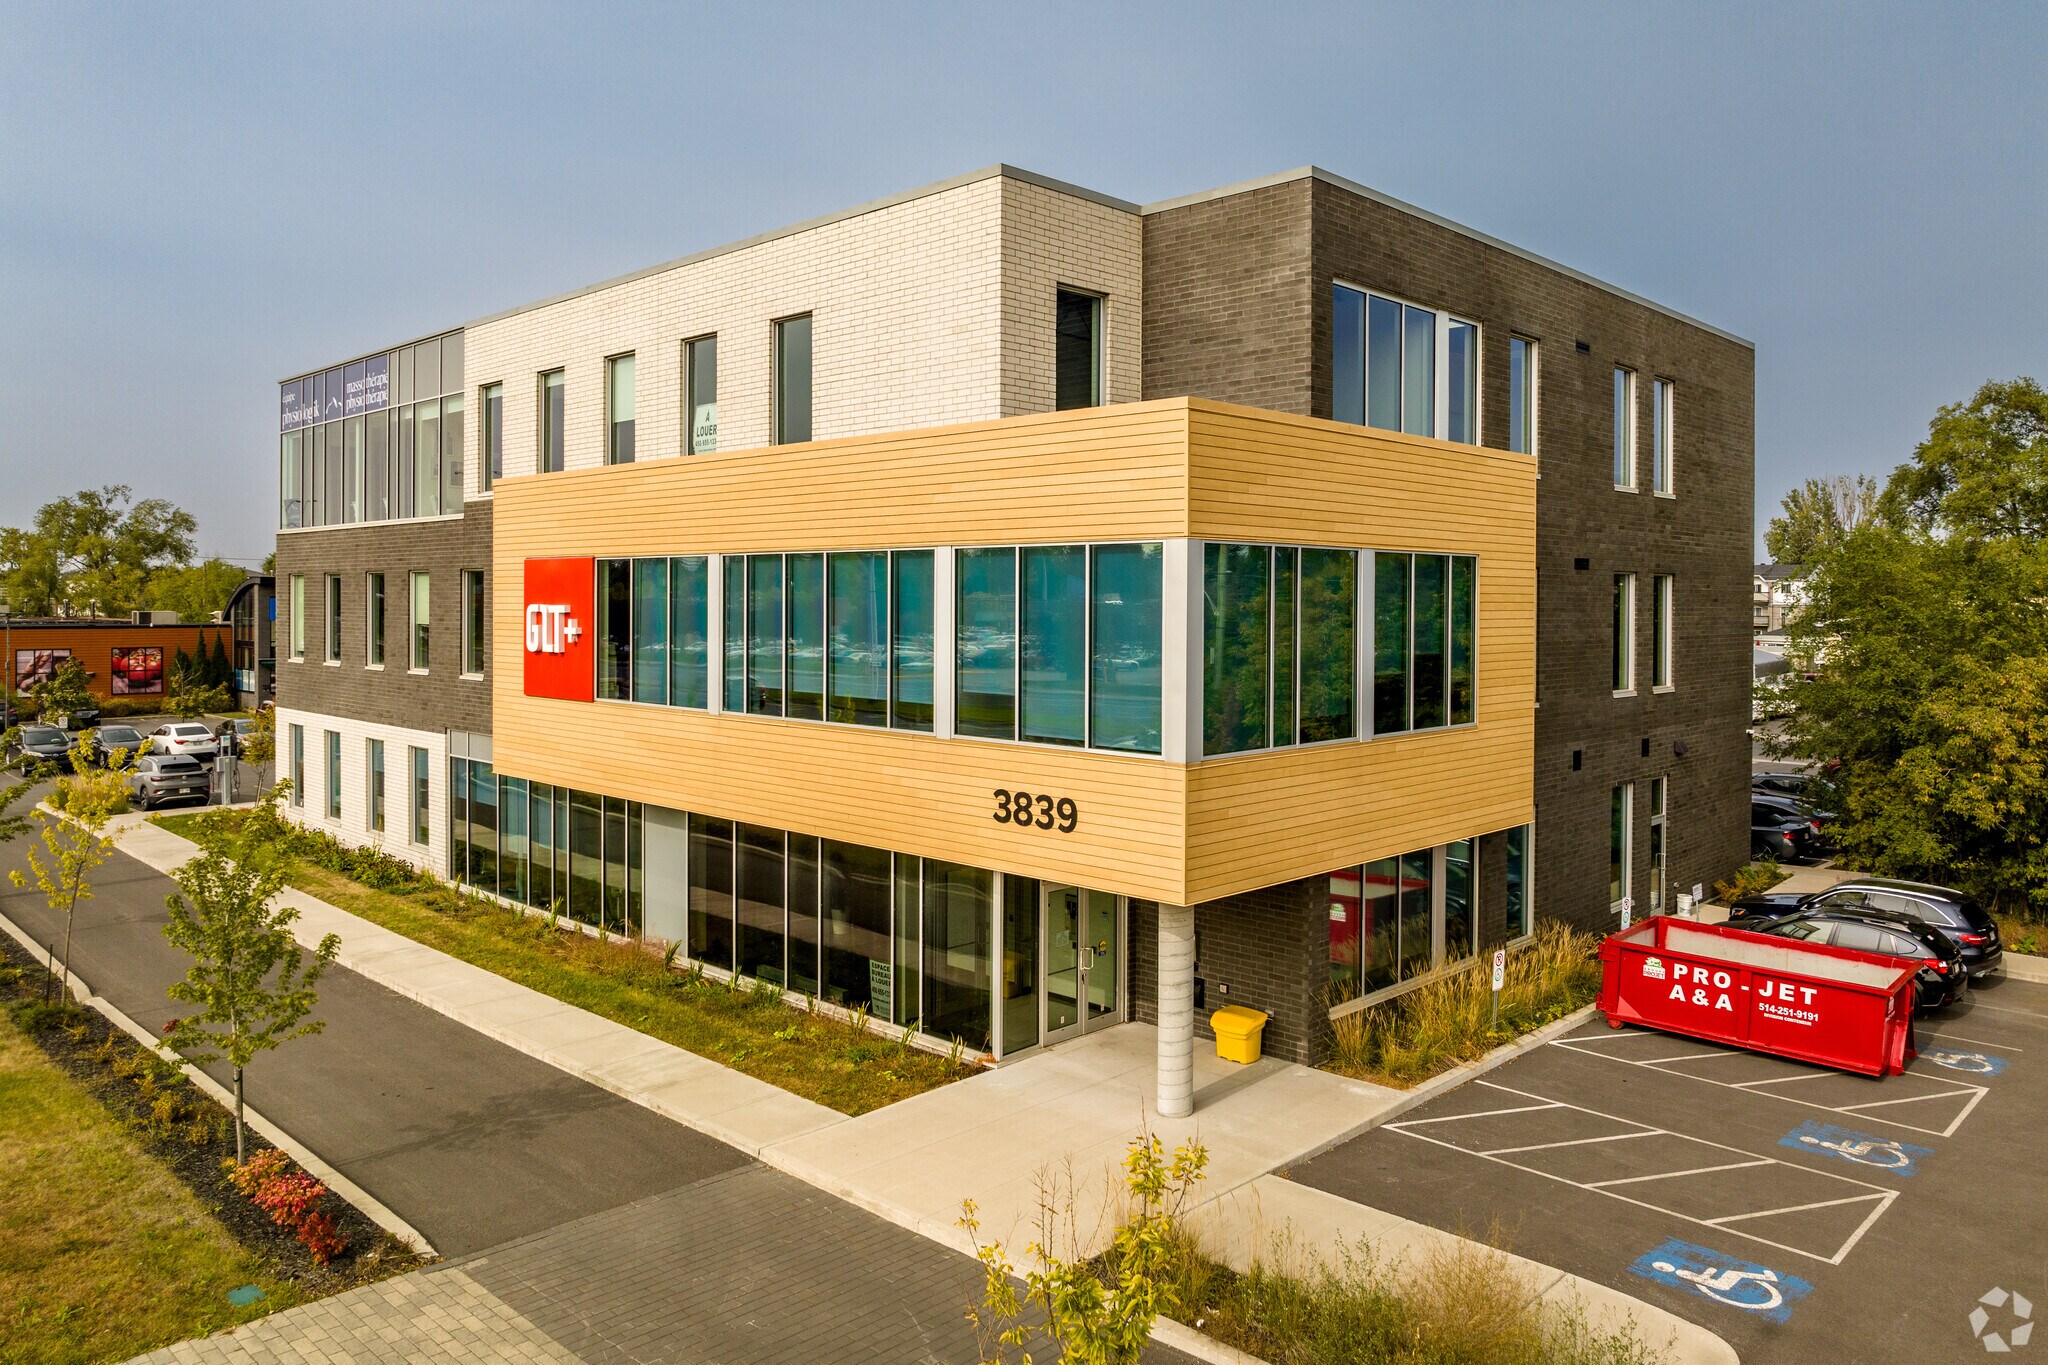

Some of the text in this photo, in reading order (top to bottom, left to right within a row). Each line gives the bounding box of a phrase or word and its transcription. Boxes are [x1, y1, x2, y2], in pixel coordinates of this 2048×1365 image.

[346, 387, 388, 413] physiothérapie
[696, 424, 717, 437] LOUER
[993, 789, 1078, 833] 3839
[872, 962, 890, 972] ESPACE
[1673, 962, 1731, 989] PRO
[1758, 980, 1818, 1005] JET
[1758, 1002, 1819, 1022] 514-251-9191
[1763, 1012, 1784, 1021] DIVISION
